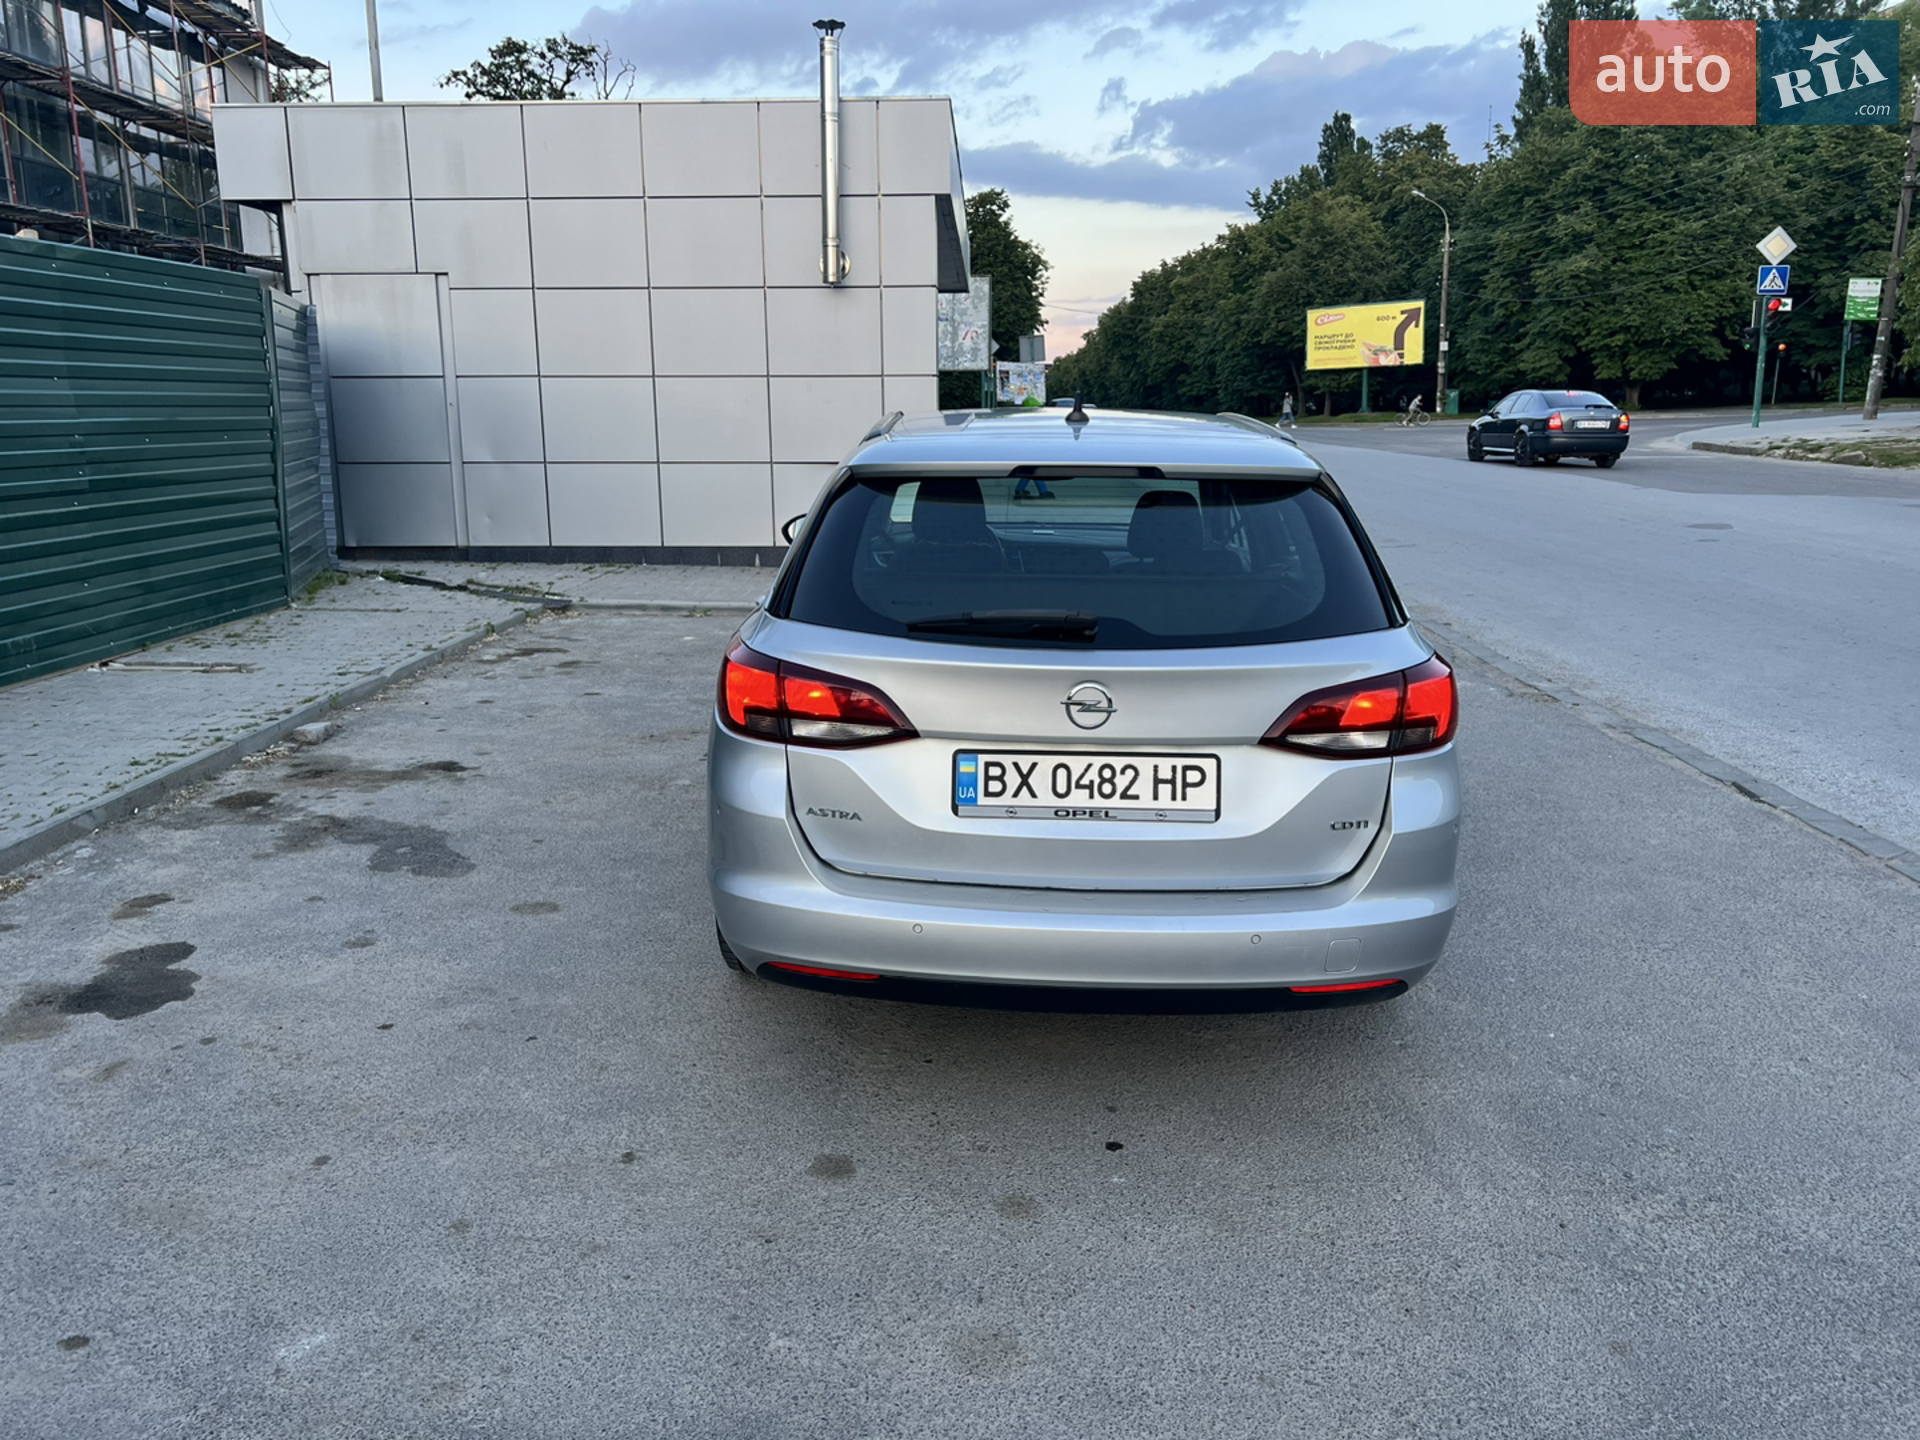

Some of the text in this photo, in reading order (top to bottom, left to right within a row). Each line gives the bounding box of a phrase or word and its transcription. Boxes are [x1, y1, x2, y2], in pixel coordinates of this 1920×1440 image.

[983, 761, 1207, 801] BX 0482 HP
[959, 786, 976, 798] UA
[806, 807, 862, 822] ASTRA
[1053, 809, 1118, 819] OPEL
